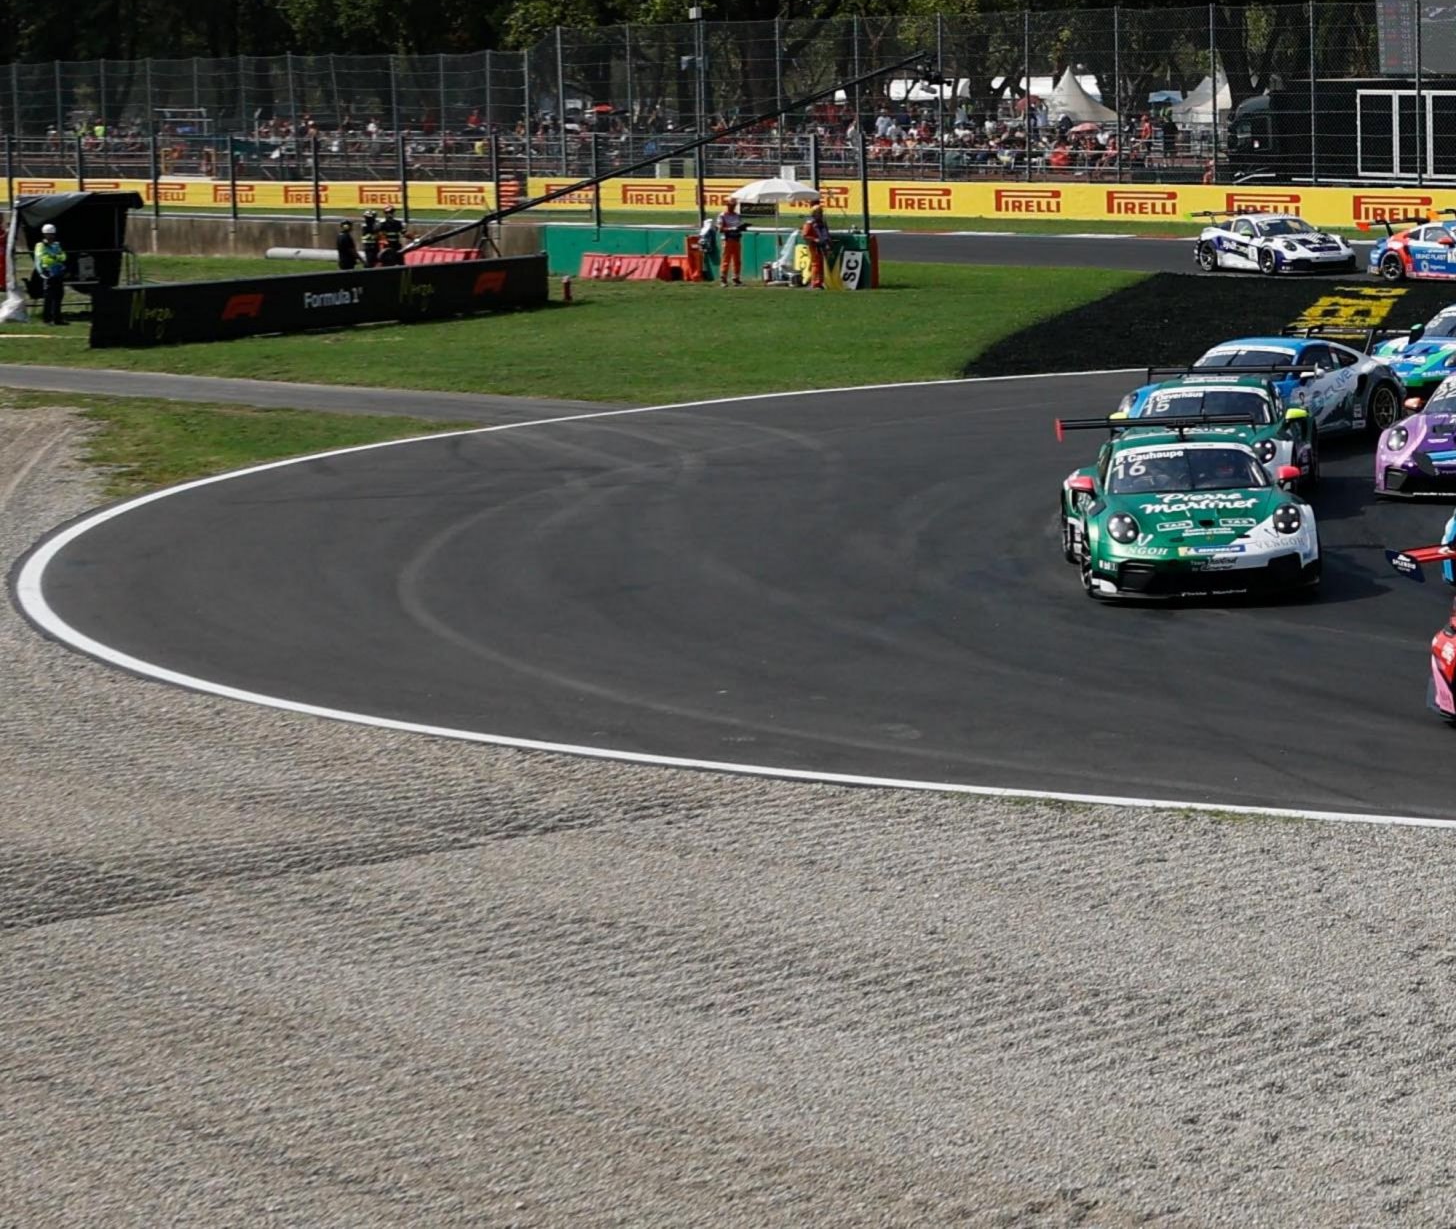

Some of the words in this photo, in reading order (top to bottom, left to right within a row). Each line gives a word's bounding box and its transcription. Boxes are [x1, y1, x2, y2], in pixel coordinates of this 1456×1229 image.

[621, 184, 675, 205] PIRELLI
[889, 187, 952, 211] PIRELLI
[995, 189, 1061, 213] PIRELLI
[1107, 190, 1178, 216] PIRELLI
[304, 288, 351, 308] Formula
[1144, 399, 1171, 415] 15
[1112, 461, 1146, 479] 16
[1115, 457, 1125, 465] P.
[1156, 492, 1243, 504] Pierre
